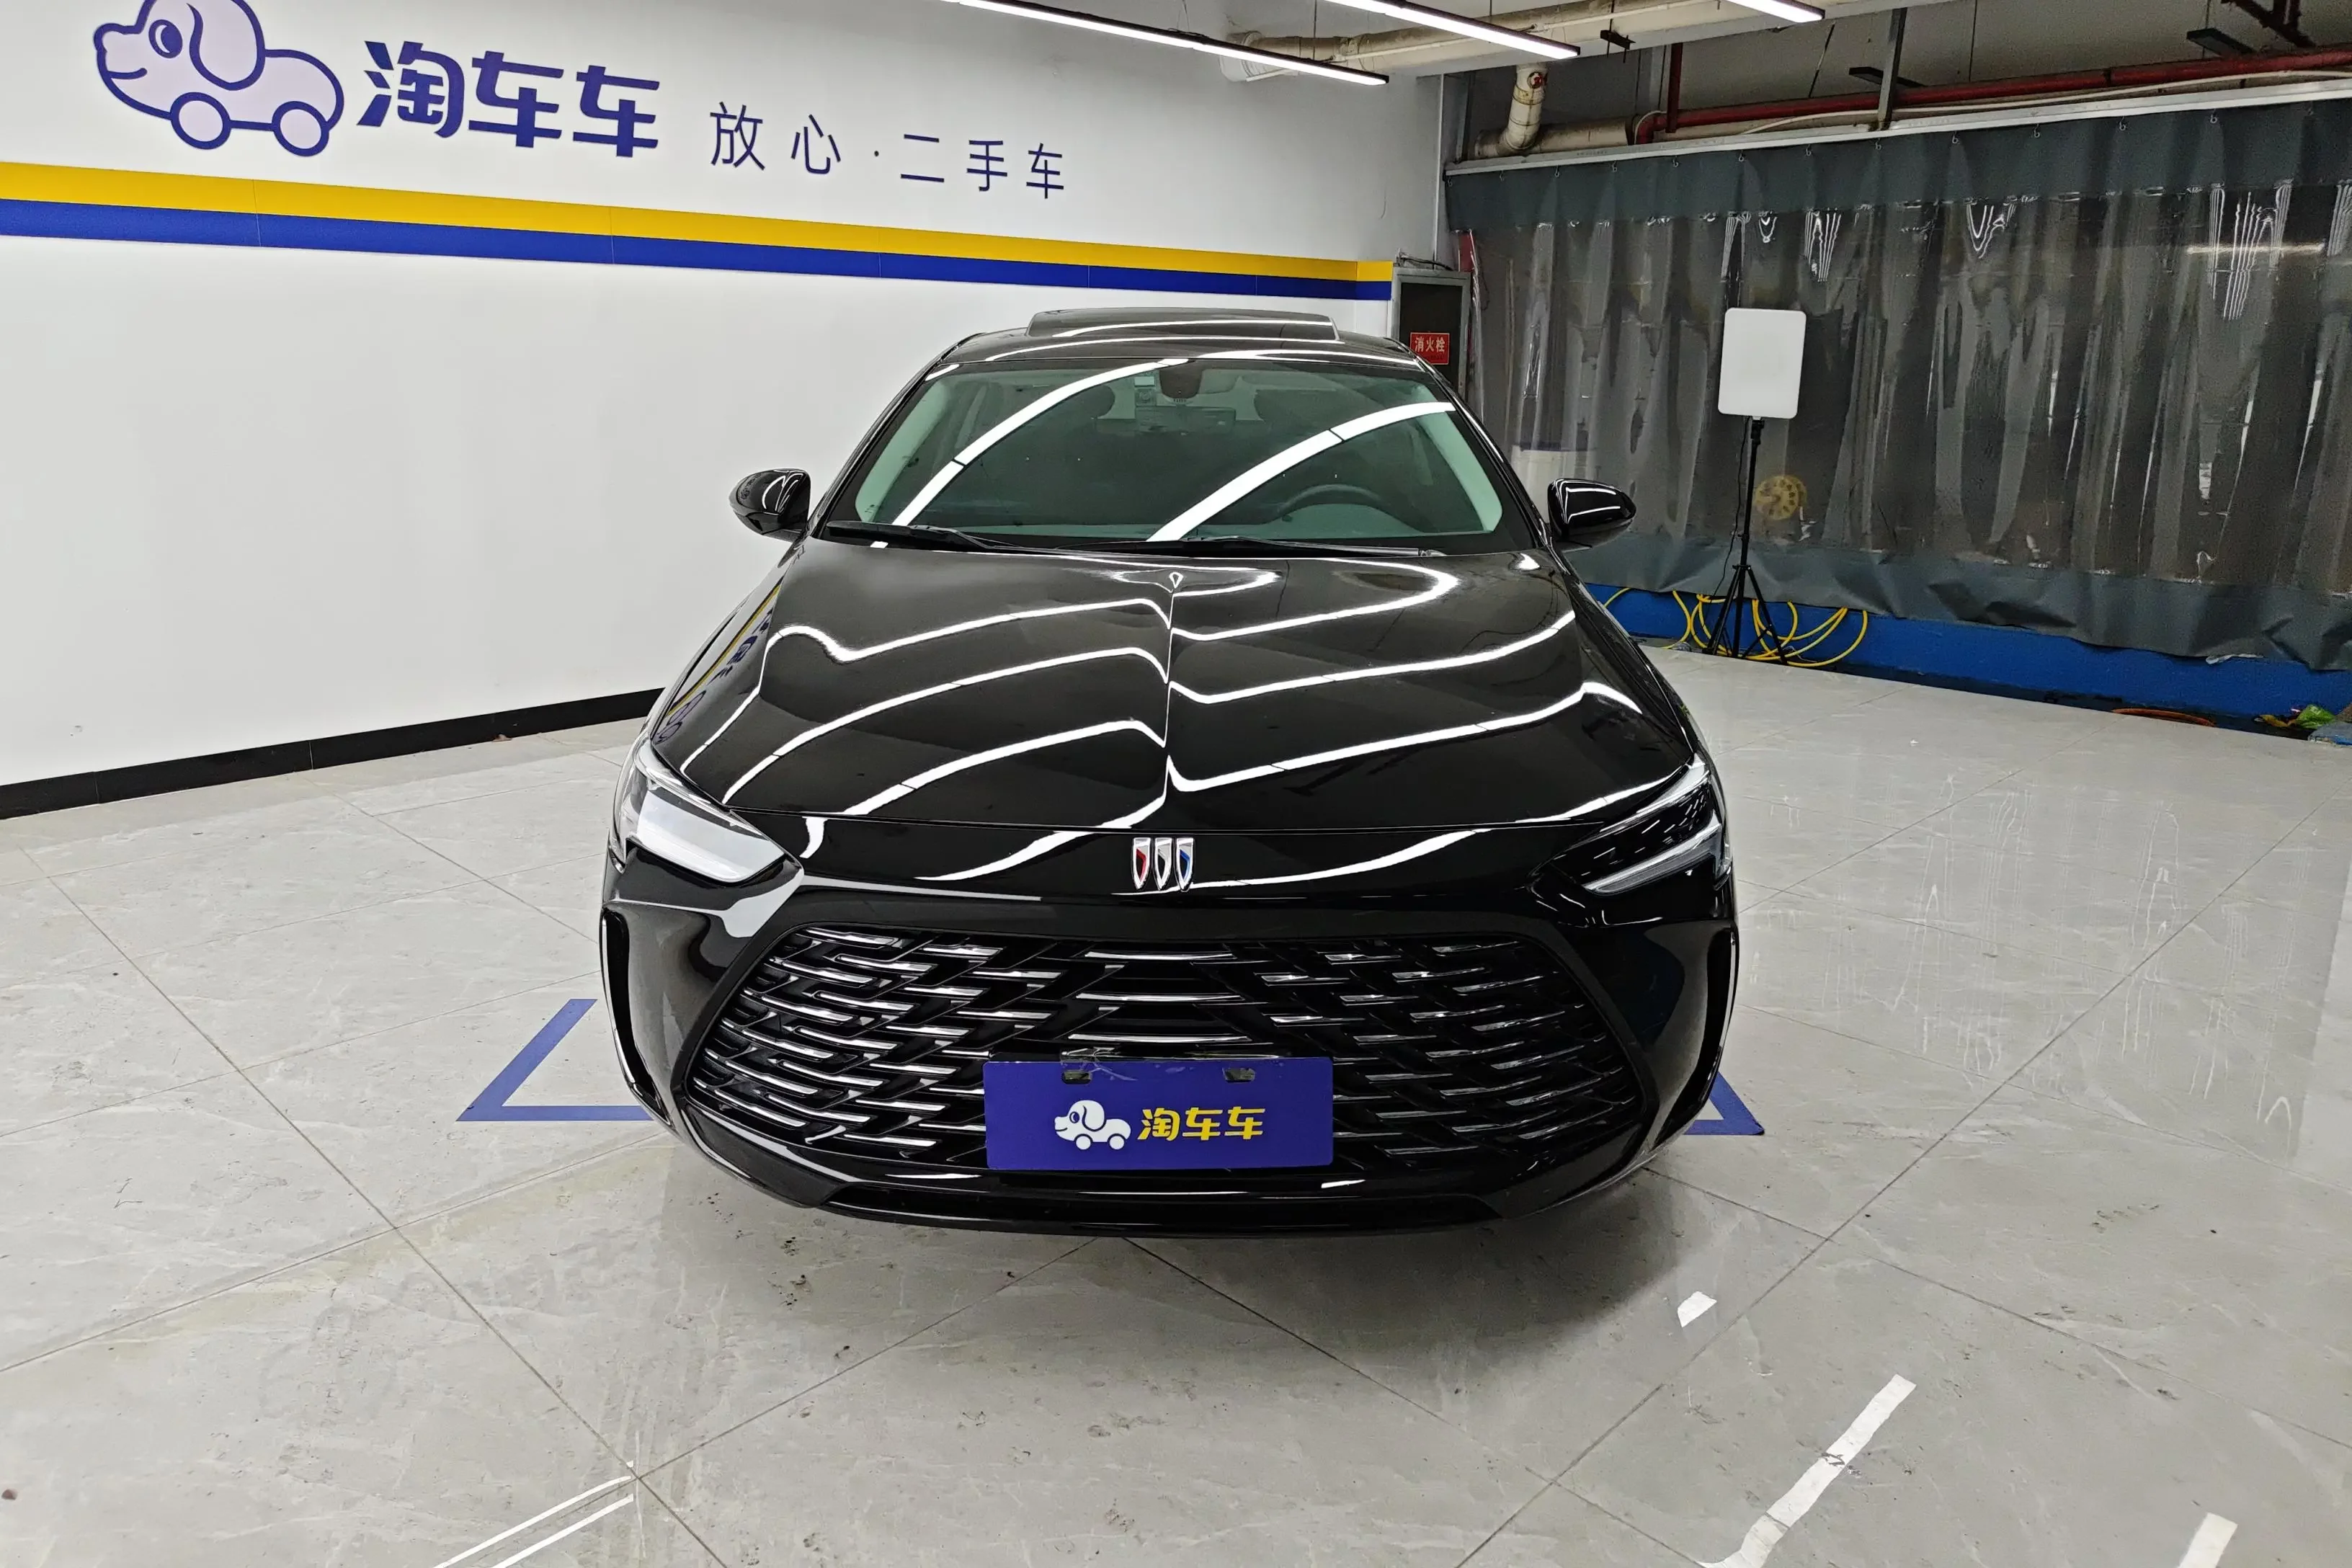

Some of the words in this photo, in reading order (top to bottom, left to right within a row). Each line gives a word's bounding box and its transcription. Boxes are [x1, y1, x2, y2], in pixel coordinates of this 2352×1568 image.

[356, 40, 660, 158] 淘车车
[1415, 336, 1446, 352] 消火栓
[1137, 1106, 1265, 1141] 淘车车
